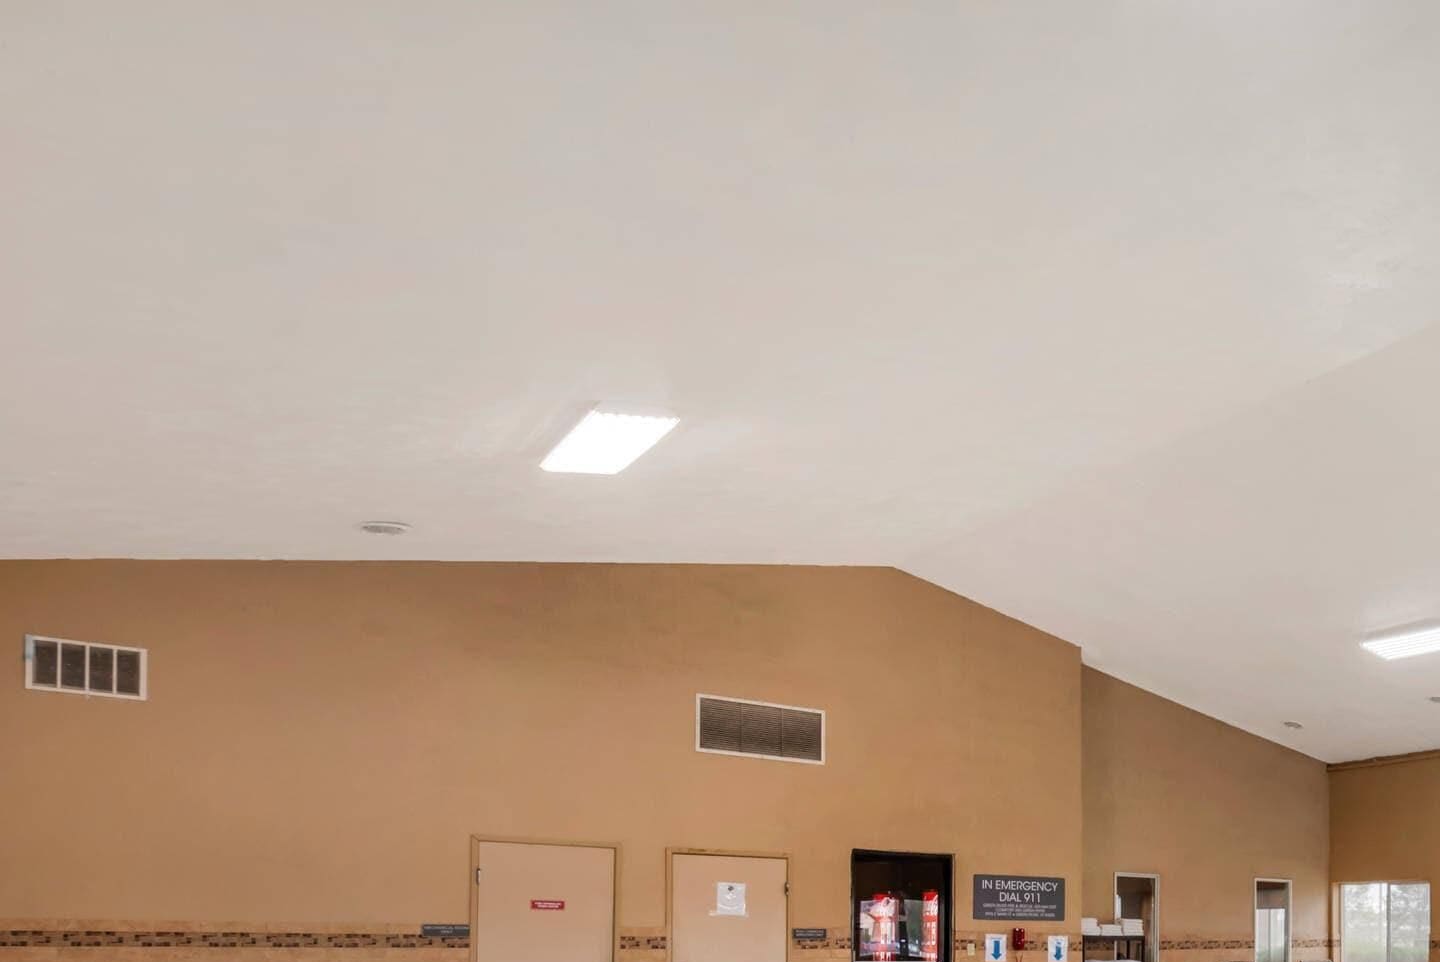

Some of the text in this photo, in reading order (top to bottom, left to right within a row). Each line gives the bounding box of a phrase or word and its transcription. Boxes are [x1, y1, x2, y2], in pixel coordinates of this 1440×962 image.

[982, 879, 1058, 892] IN EMERGENCY
[1000, 892, 1040, 903] DIAL 911
